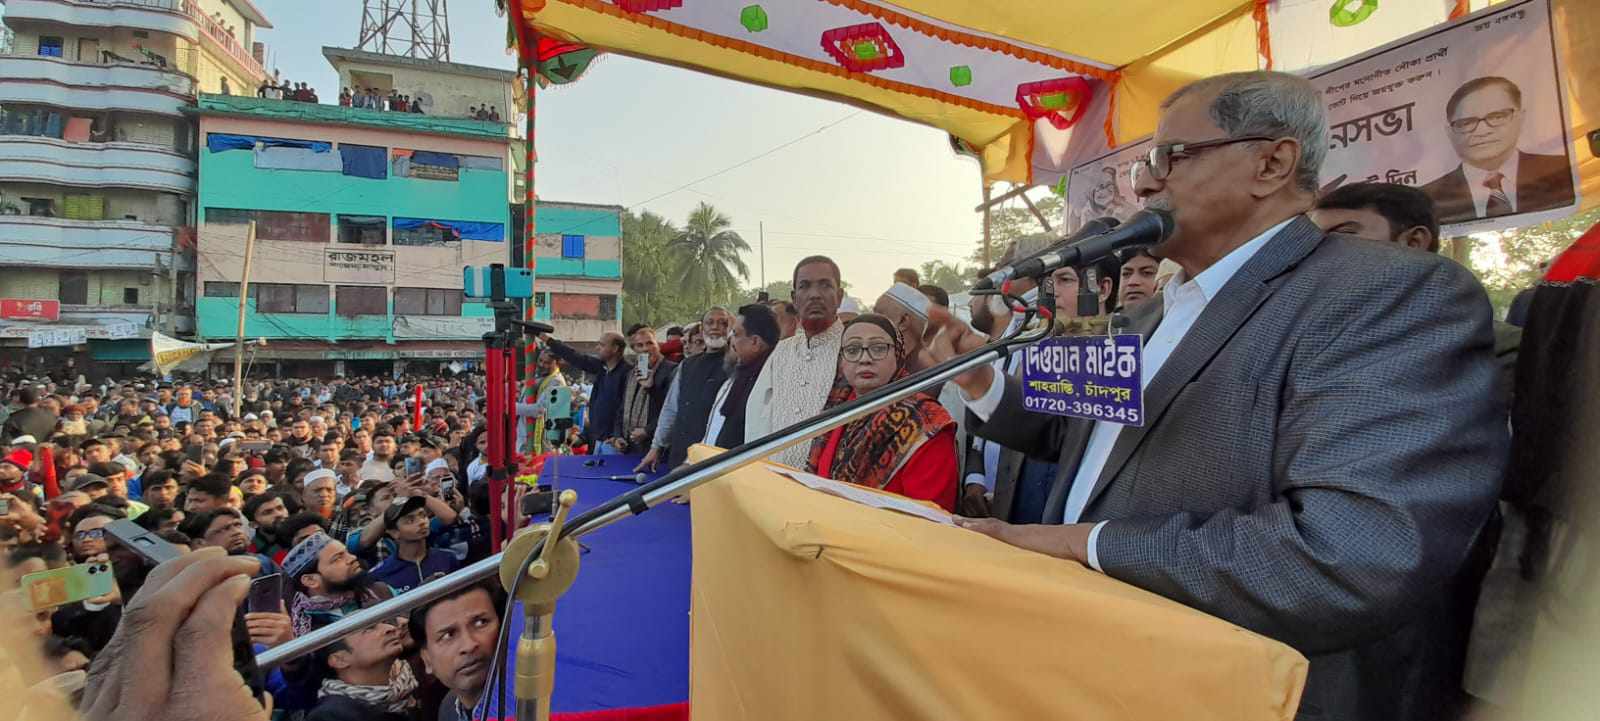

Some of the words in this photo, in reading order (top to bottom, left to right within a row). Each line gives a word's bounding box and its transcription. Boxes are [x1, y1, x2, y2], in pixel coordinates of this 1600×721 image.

[1395, 57, 1421, 72] নৌকা
[1330, 101, 1415, 149] নসভা
[1085, 339, 1137, 378] মাইক
[1084, 380, 1131, 402] চাঁদপুর
[1025, 396, 1139, 422] 01720-396345
